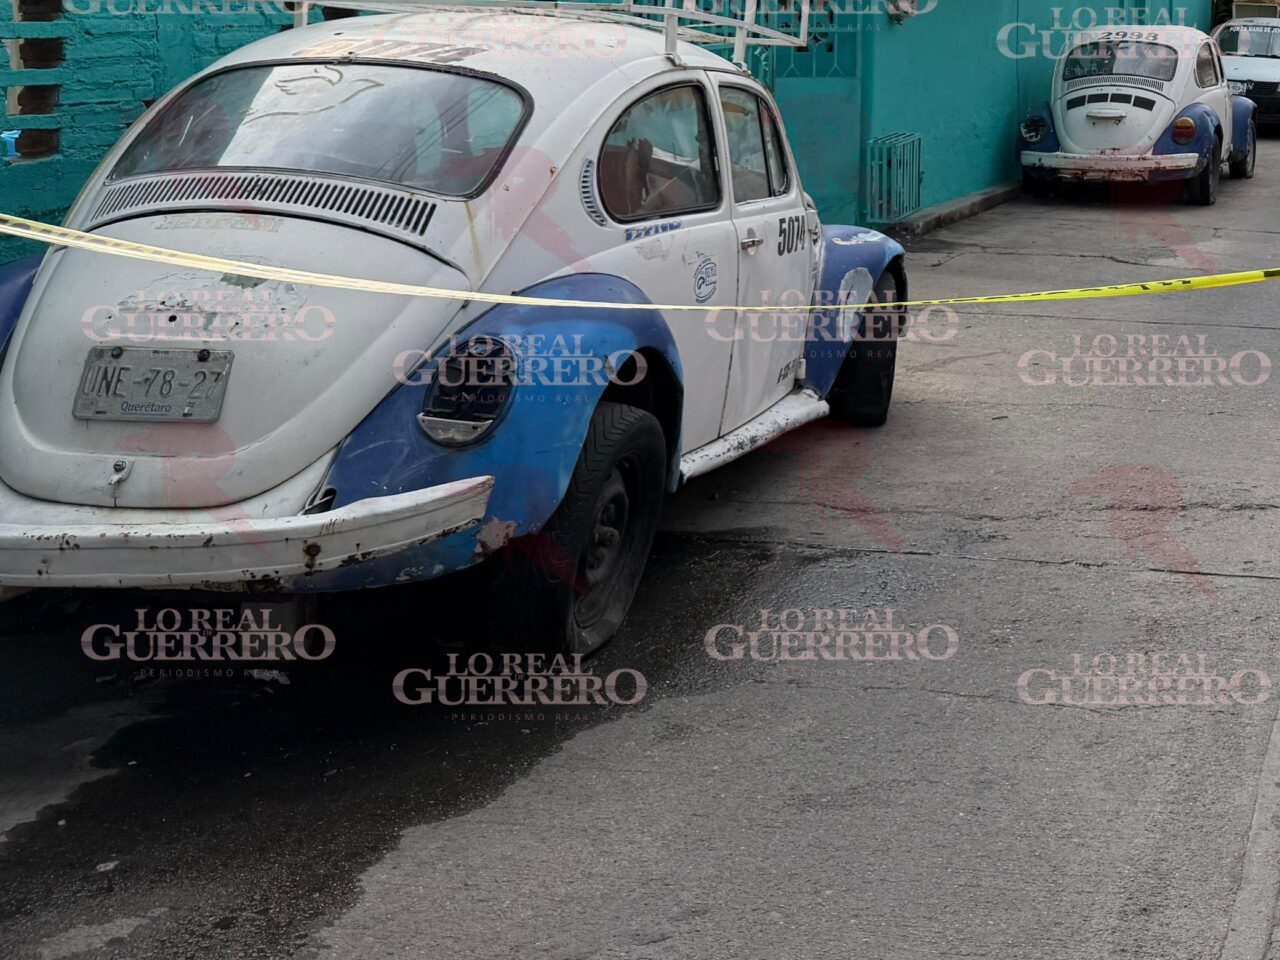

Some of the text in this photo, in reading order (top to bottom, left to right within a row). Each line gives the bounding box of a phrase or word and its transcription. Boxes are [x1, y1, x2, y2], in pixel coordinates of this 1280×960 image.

[1098, 31, 1159, 41] 2998
[777, 215, 806, 257] 5074
[82, 365, 225, 400] UNE-78-27
[120, 401, 172, 413] Querétaro
